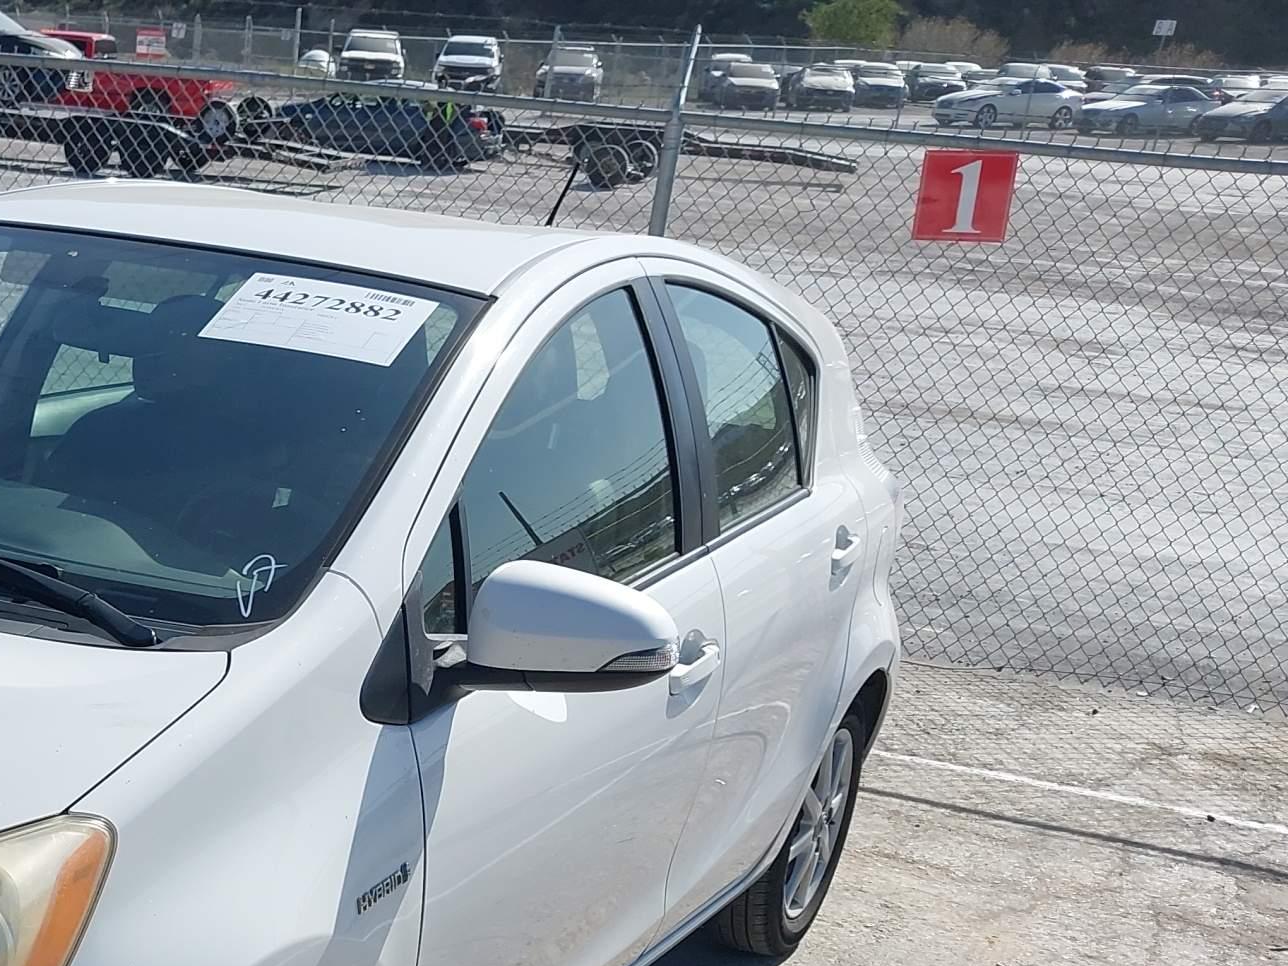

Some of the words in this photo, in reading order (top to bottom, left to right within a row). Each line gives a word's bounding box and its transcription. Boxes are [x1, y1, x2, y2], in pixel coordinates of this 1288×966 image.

[941, 159, 983, 234] 1
[254, 288, 402, 322] 44272882
[356, 868, 403, 915] HYBRID
